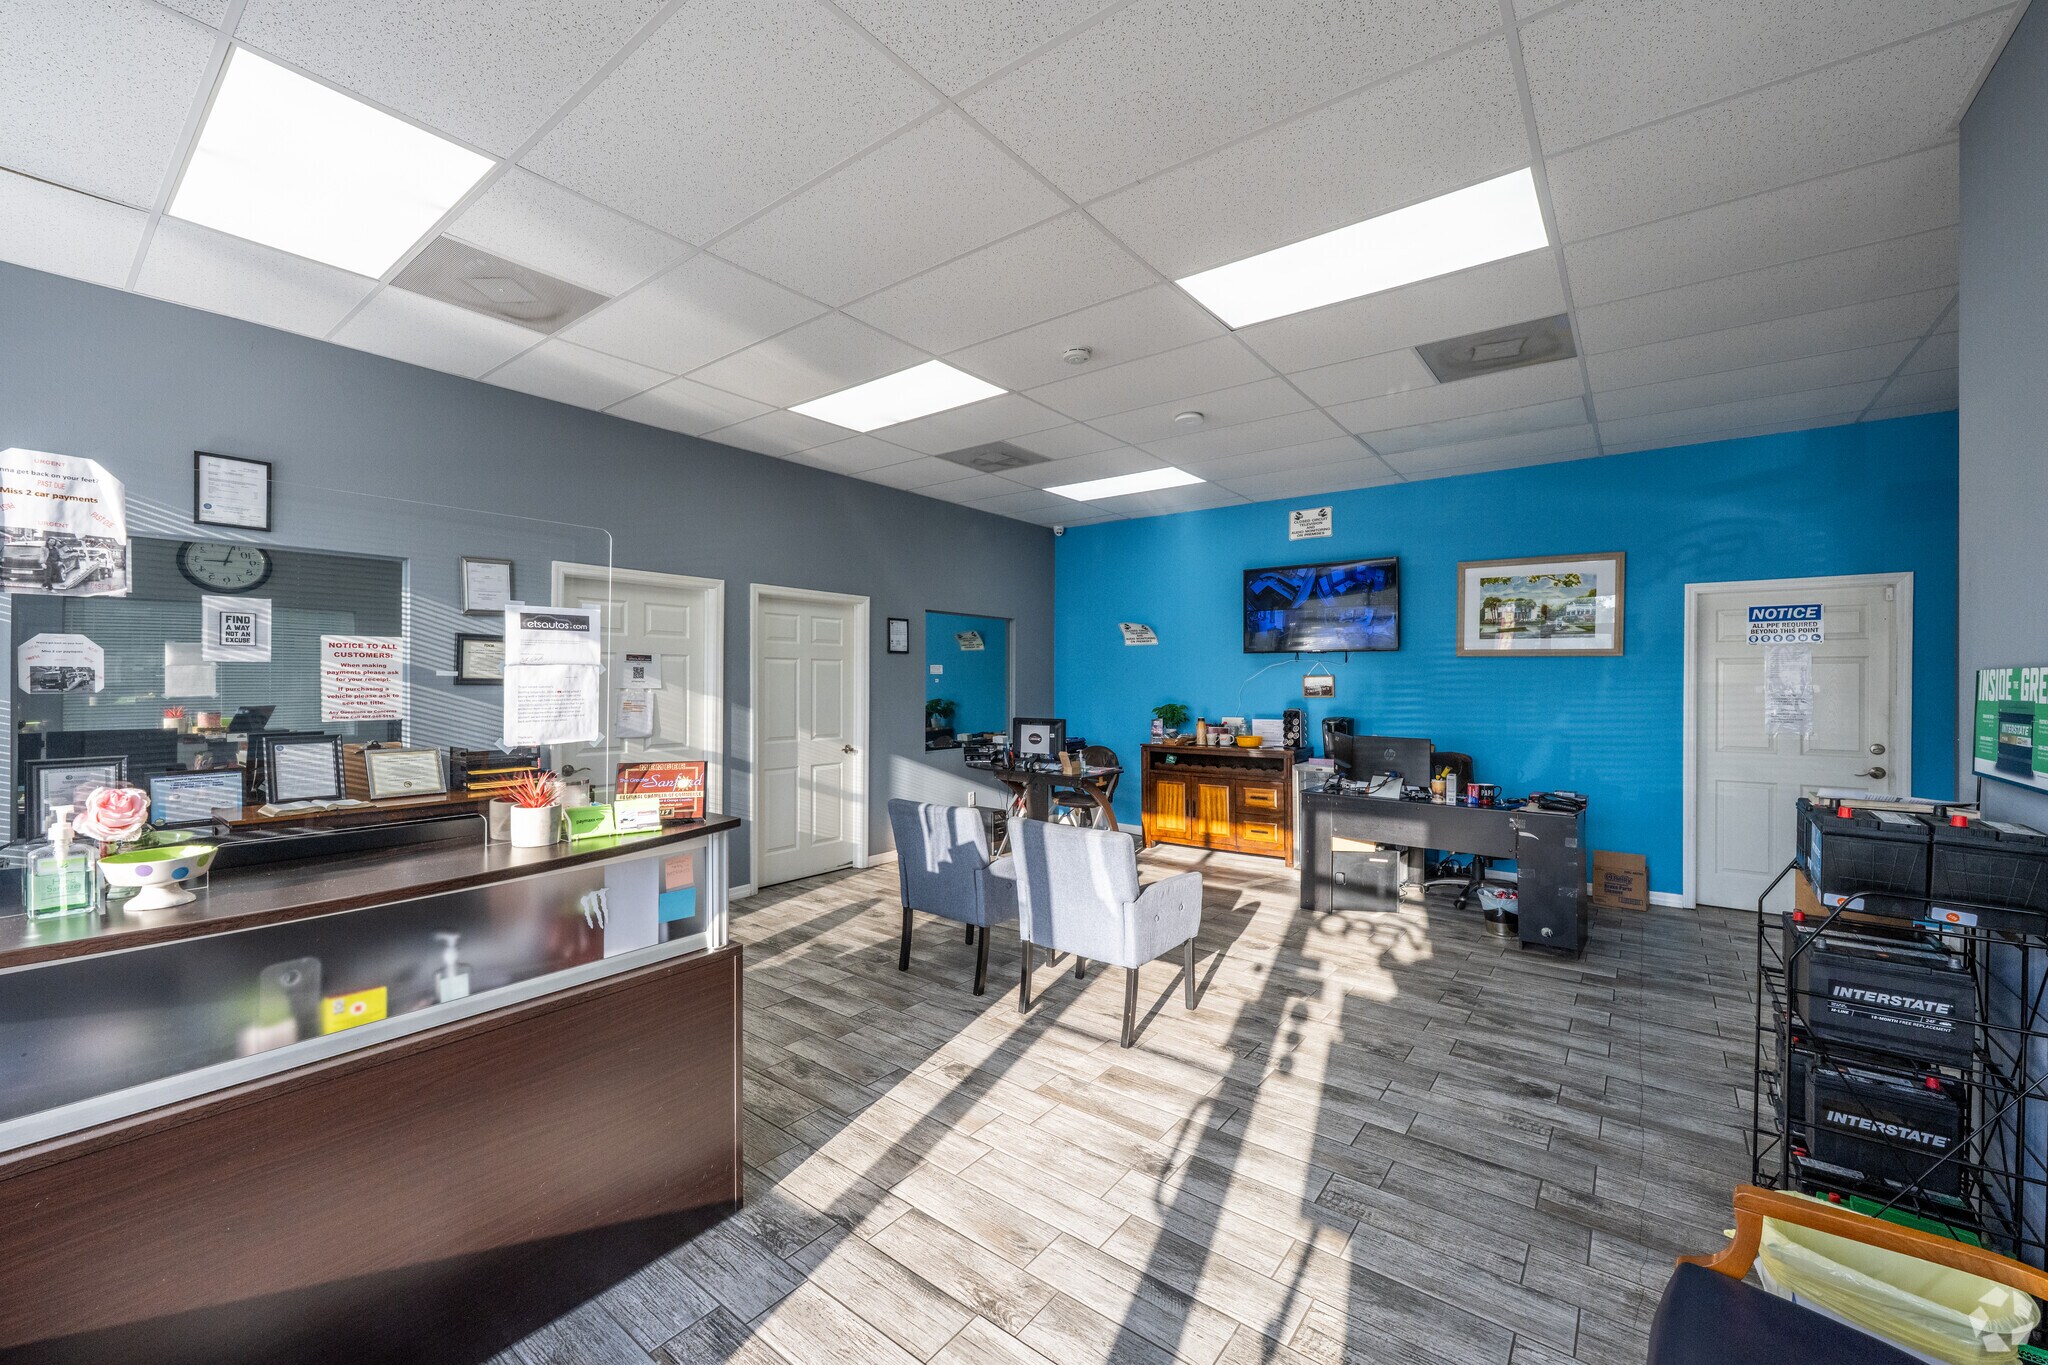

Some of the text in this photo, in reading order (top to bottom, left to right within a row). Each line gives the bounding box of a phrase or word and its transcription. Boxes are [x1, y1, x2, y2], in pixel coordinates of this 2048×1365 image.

[34, 458, 65, 467] URGENT
[54, 482, 65, 490] DUE
[0, 487, 23, 495] Miss
[52, 493, 98, 504] payments
[34, 519, 69, 529] URGENT
[1752, 606, 1818, 620] NOTICE
[226, 615, 250, 624] FIND
[526, 620, 588, 630] etsautos.com
[1978, 668, 2013, 702] INSIDE
[2021, 667, 2048, 704] GRE
[2001, 723, 2030, 737] INTERSTATE
[640, 763, 686, 771] MEMBER
[1832, 985, 1951, 1015] INTERSTATE
[1831, 1007, 1849, 1015] M-LINE
[1871, 1015, 1899, 1024] 18-MONTH
[1912, 1021, 1952, 1033] REPLACEMENT
[1826, 1110, 1949, 1148] INTERSTATE
